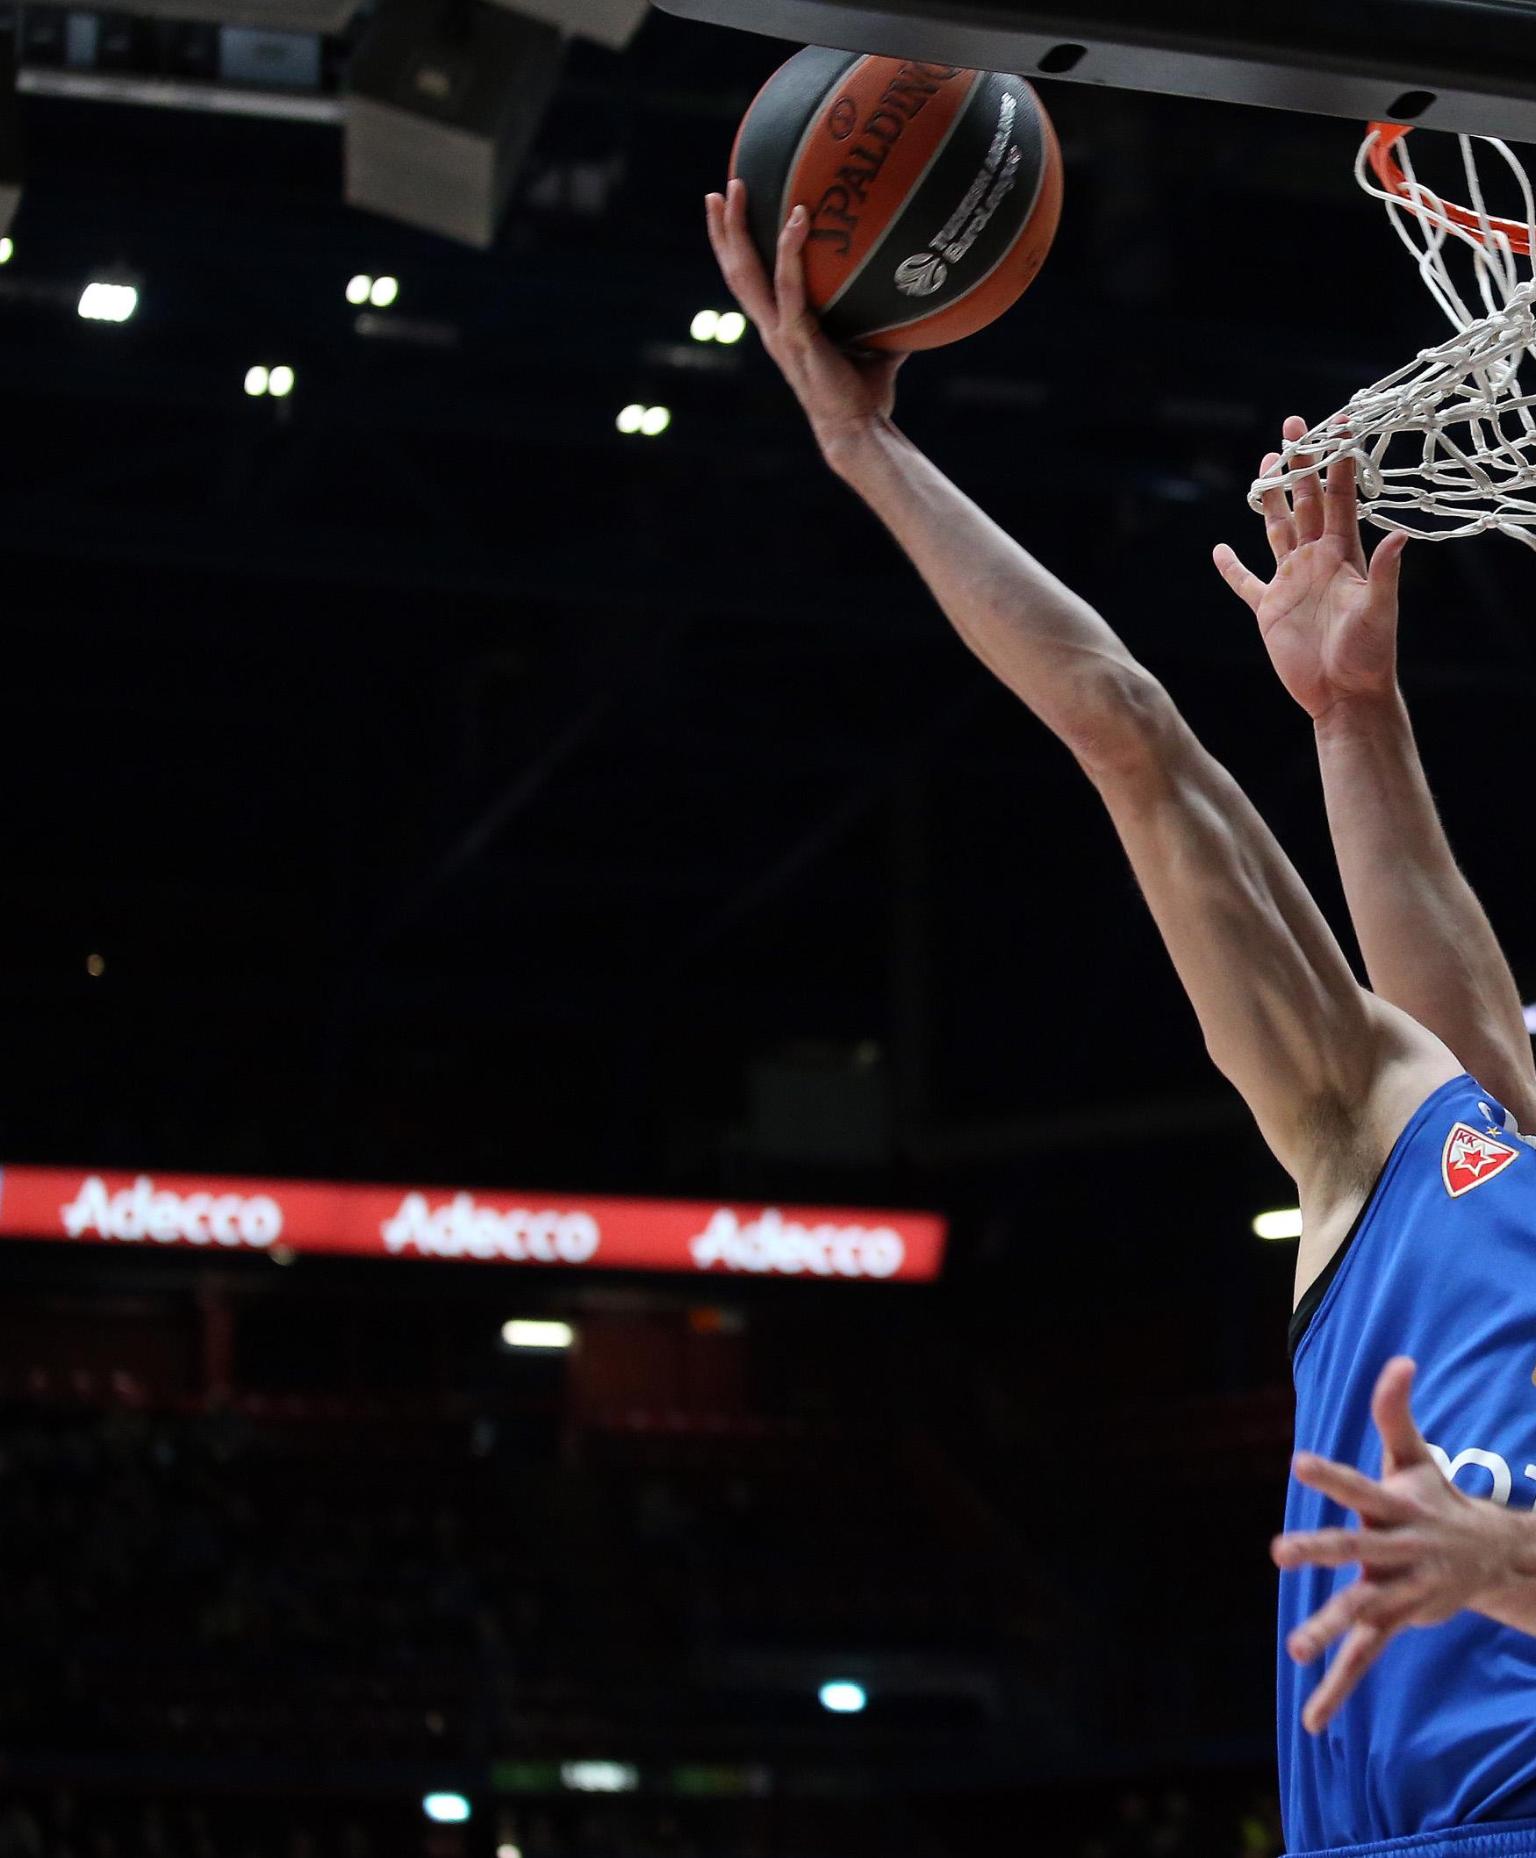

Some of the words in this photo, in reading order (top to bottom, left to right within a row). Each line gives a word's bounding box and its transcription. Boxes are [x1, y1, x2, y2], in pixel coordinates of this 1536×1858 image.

[62, 1175, 283, 1247] Adecco
[381, 1193, 600, 1263] Adecco
[689, 1208, 905, 1279] Adecco
